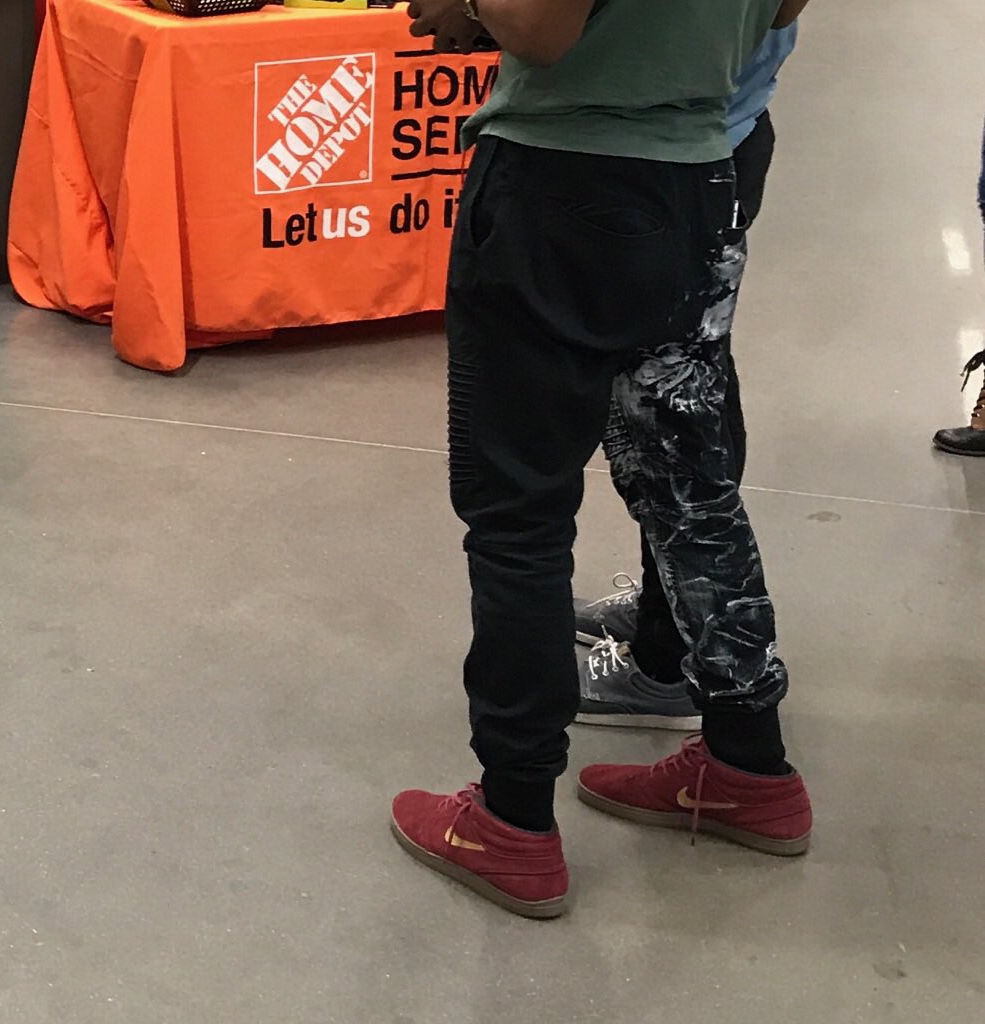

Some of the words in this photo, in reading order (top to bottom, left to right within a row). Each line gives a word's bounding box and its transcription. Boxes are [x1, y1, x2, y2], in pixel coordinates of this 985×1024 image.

[255, 56, 375, 191] HOME
[267, 73, 318, 128] THE
[300, 101, 372, 186] DEPOT
[262, 203, 318, 249] Let
[322, 205, 371, 240] us
[390, 193, 430, 235] do
